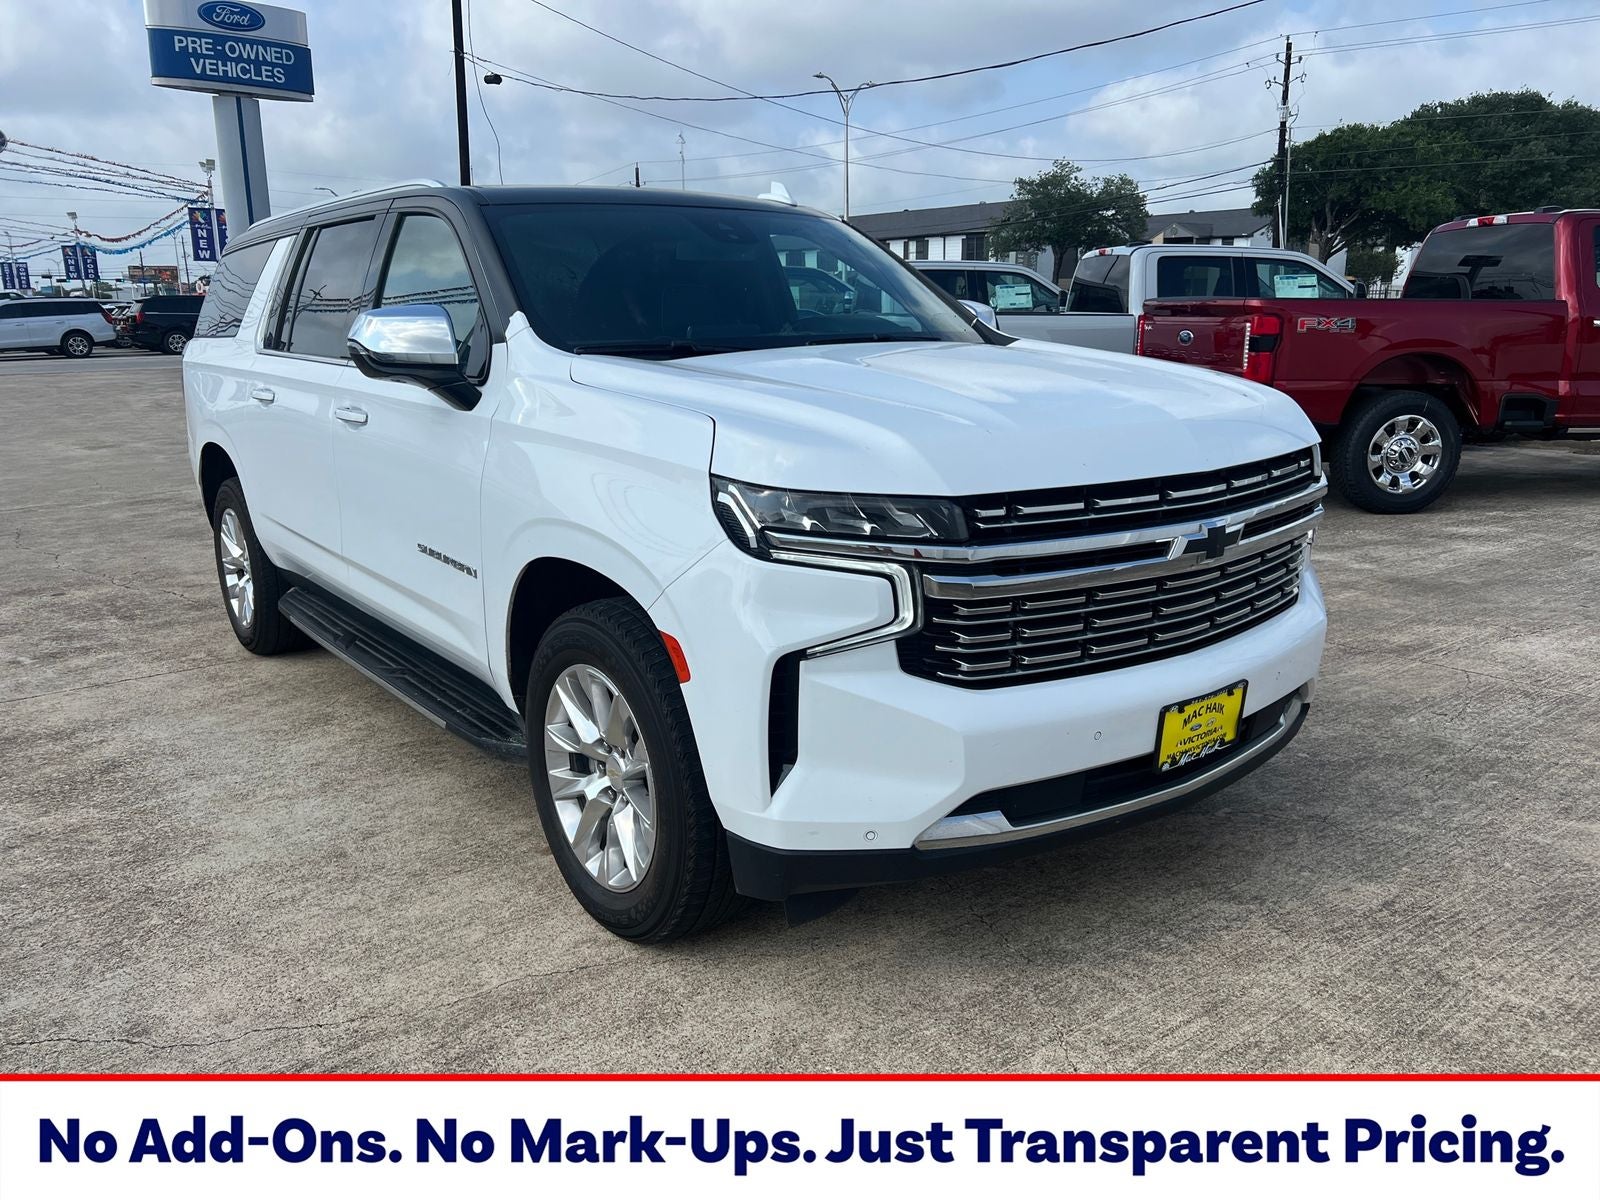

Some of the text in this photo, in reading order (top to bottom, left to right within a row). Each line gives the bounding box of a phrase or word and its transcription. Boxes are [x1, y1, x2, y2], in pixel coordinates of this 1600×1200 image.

[212, 5, 250, 26] Ford
[190, 57, 285, 84] VEHICLES
[197, 228, 210, 259] NEW
[67, 258, 78, 279] NEW
[86, 258, 95, 279] FORD
[1297, 317, 1356, 333] FX4
[1182, 702, 1225, 730] MAC HAIK
